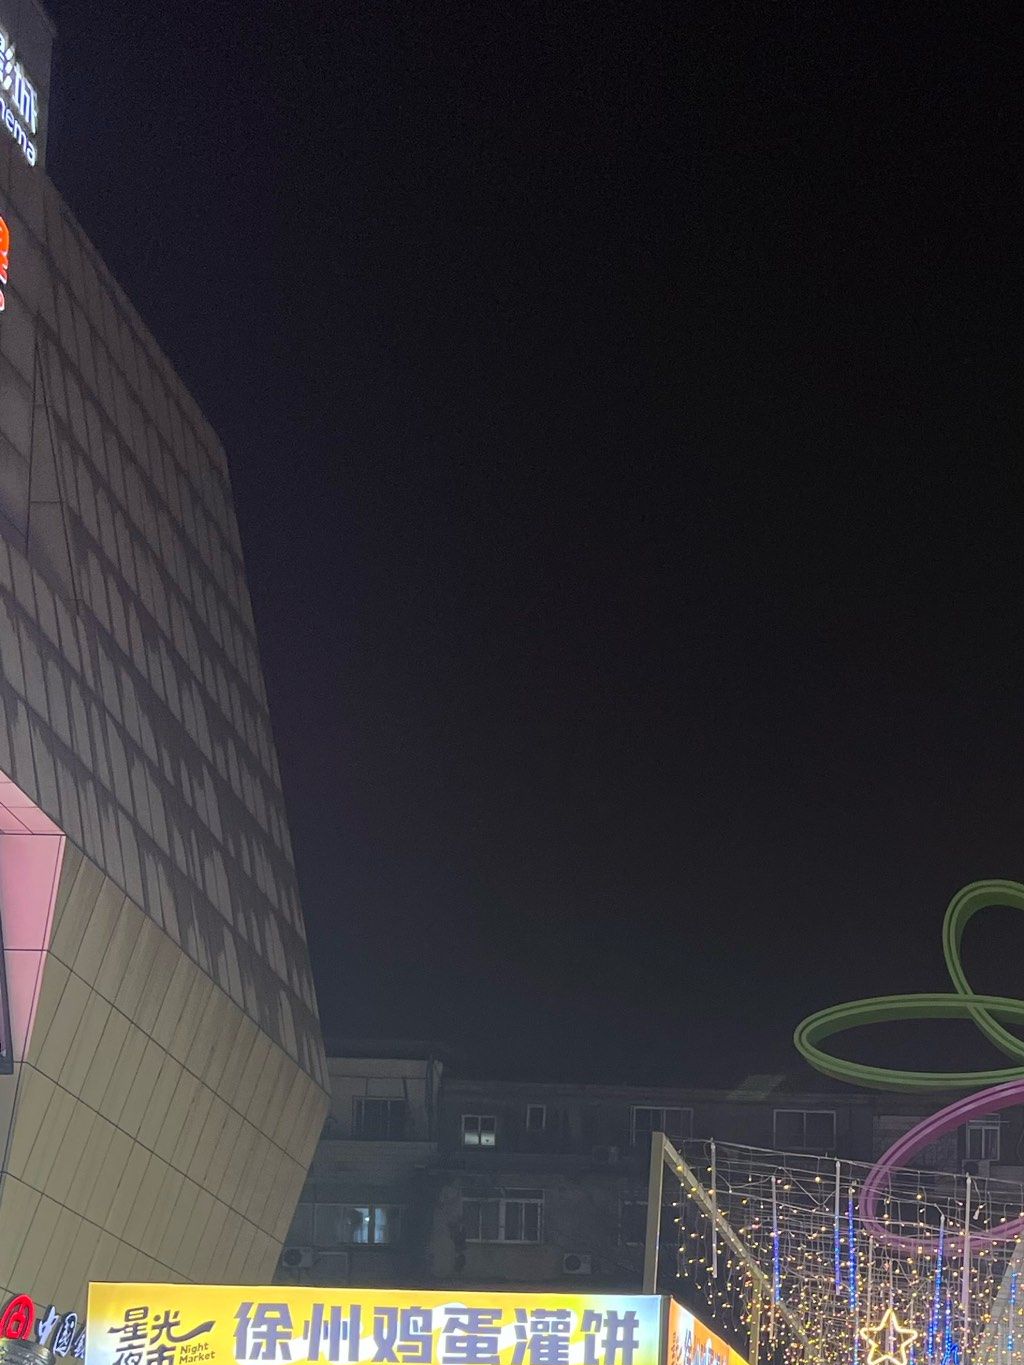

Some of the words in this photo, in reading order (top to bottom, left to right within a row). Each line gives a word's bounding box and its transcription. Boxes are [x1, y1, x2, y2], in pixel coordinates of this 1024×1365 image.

[107, 1305, 216, 1346] 星光
[180, 1341, 210, 1356] Night
[179, 1350, 216, 1365] Market
